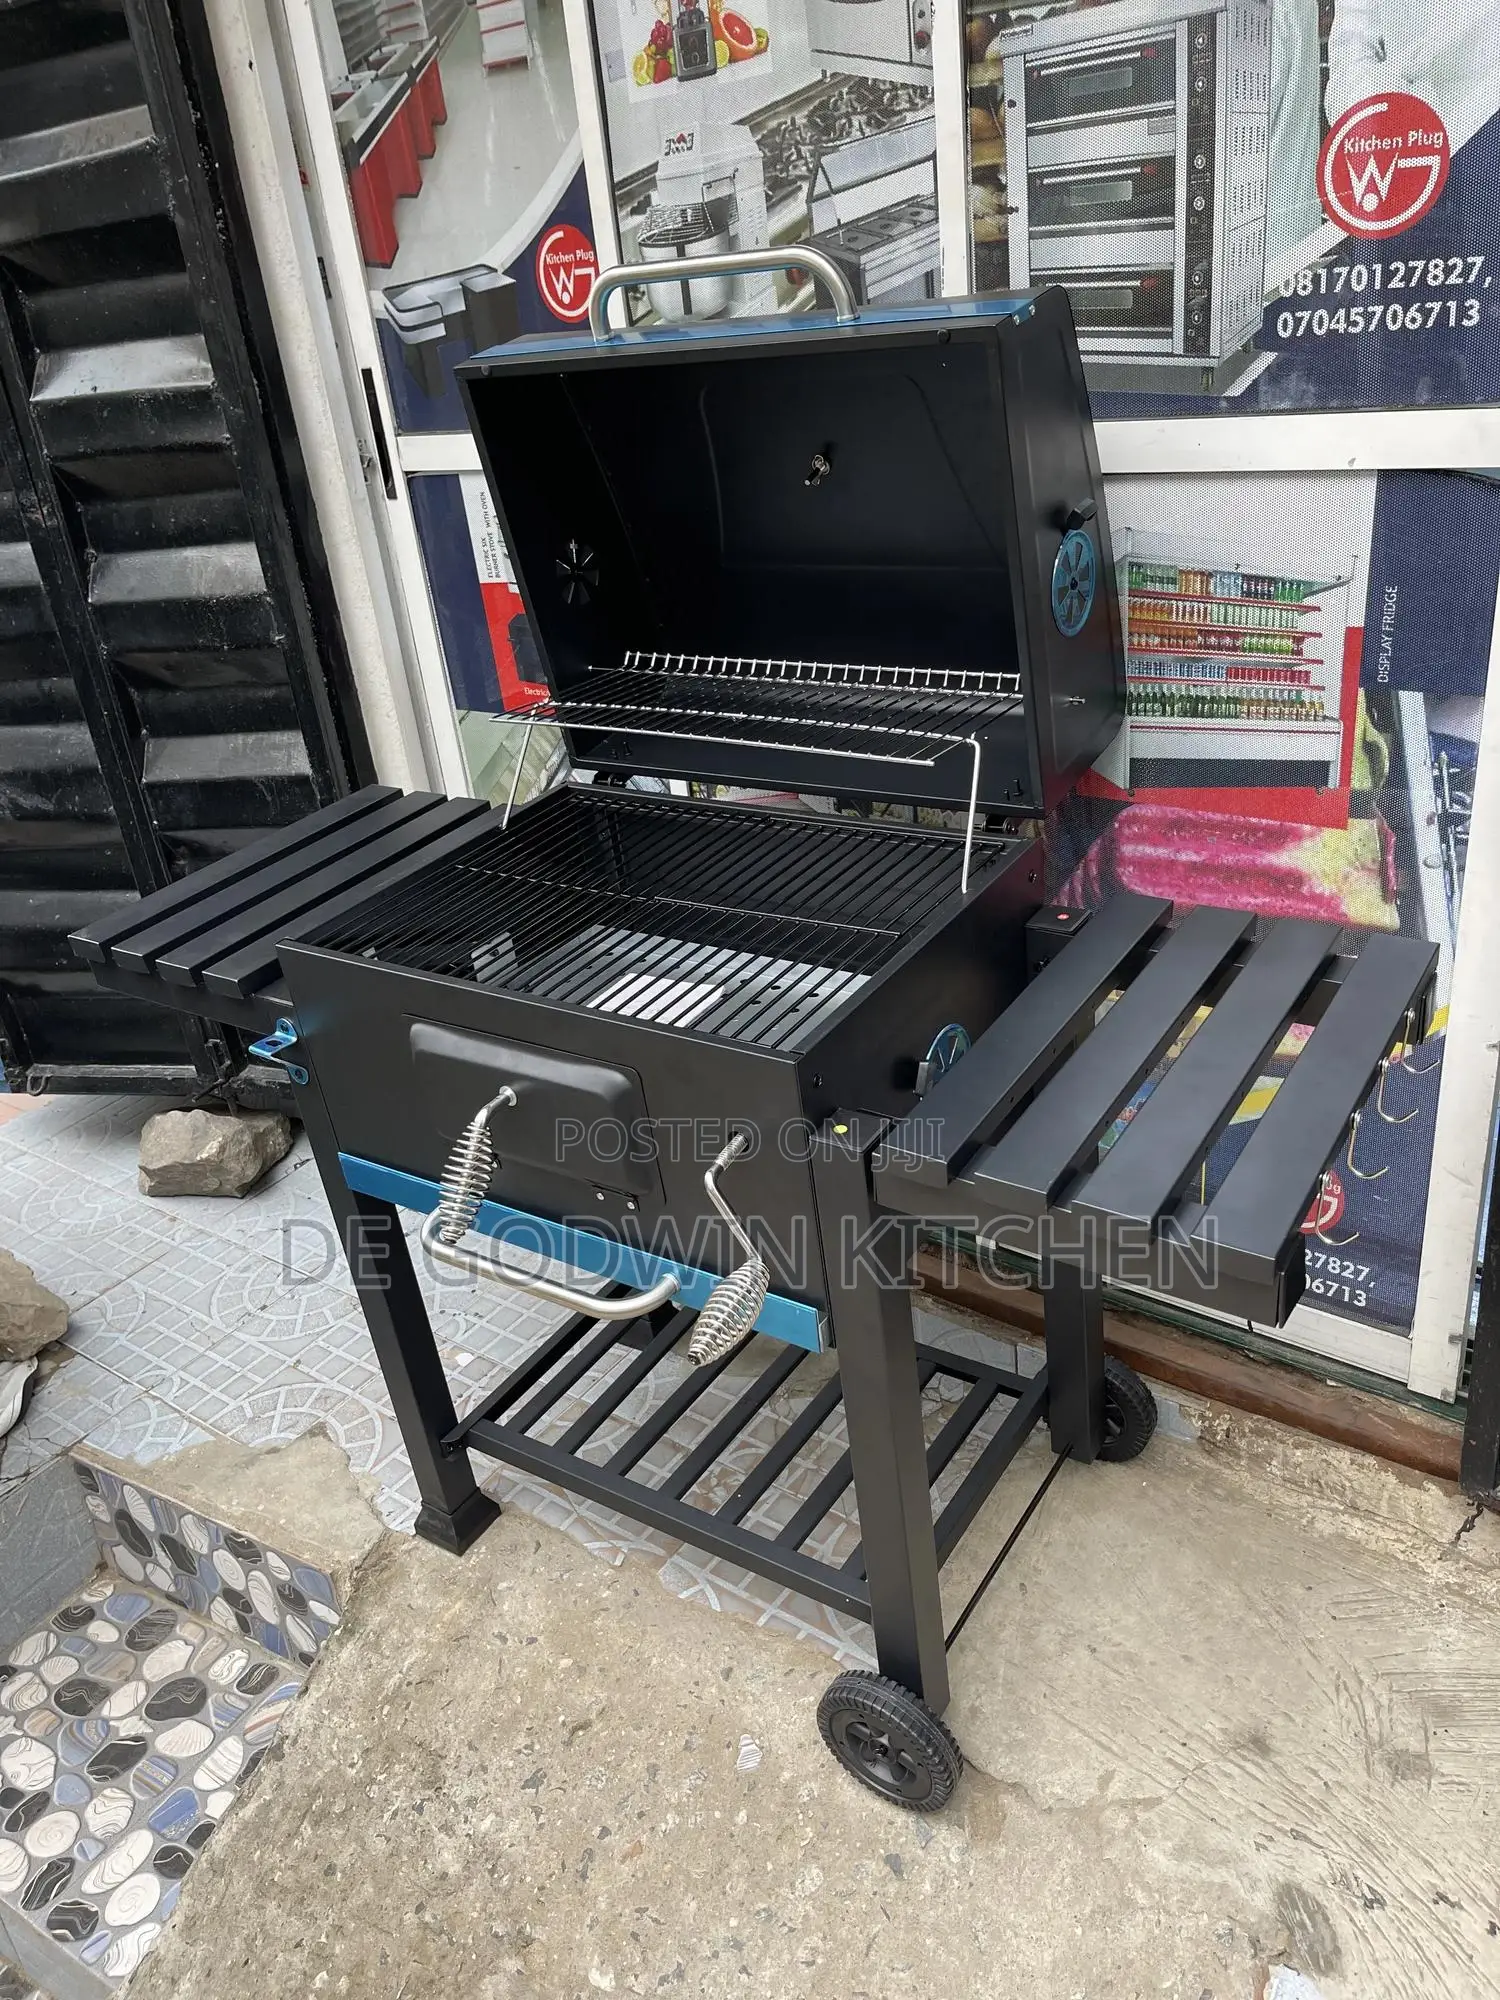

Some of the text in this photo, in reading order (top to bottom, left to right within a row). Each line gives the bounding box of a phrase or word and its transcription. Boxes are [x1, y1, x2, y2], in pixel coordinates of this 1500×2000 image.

[1344, 128, 1443, 154] Kitchen Plug
[545, 249, 595, 265] Kitchen Plug
[1278, 256, 1492, 297] 08170127827,
[1277, 300, 1480, 338] 07045706713
[480, 492, 501, 579] BURNER STOVE WITH OVEN
[480, 537, 494, 579] ELECTRIC SIX
[1377, 585, 1398, 683] DISPLAY FRIDGE
